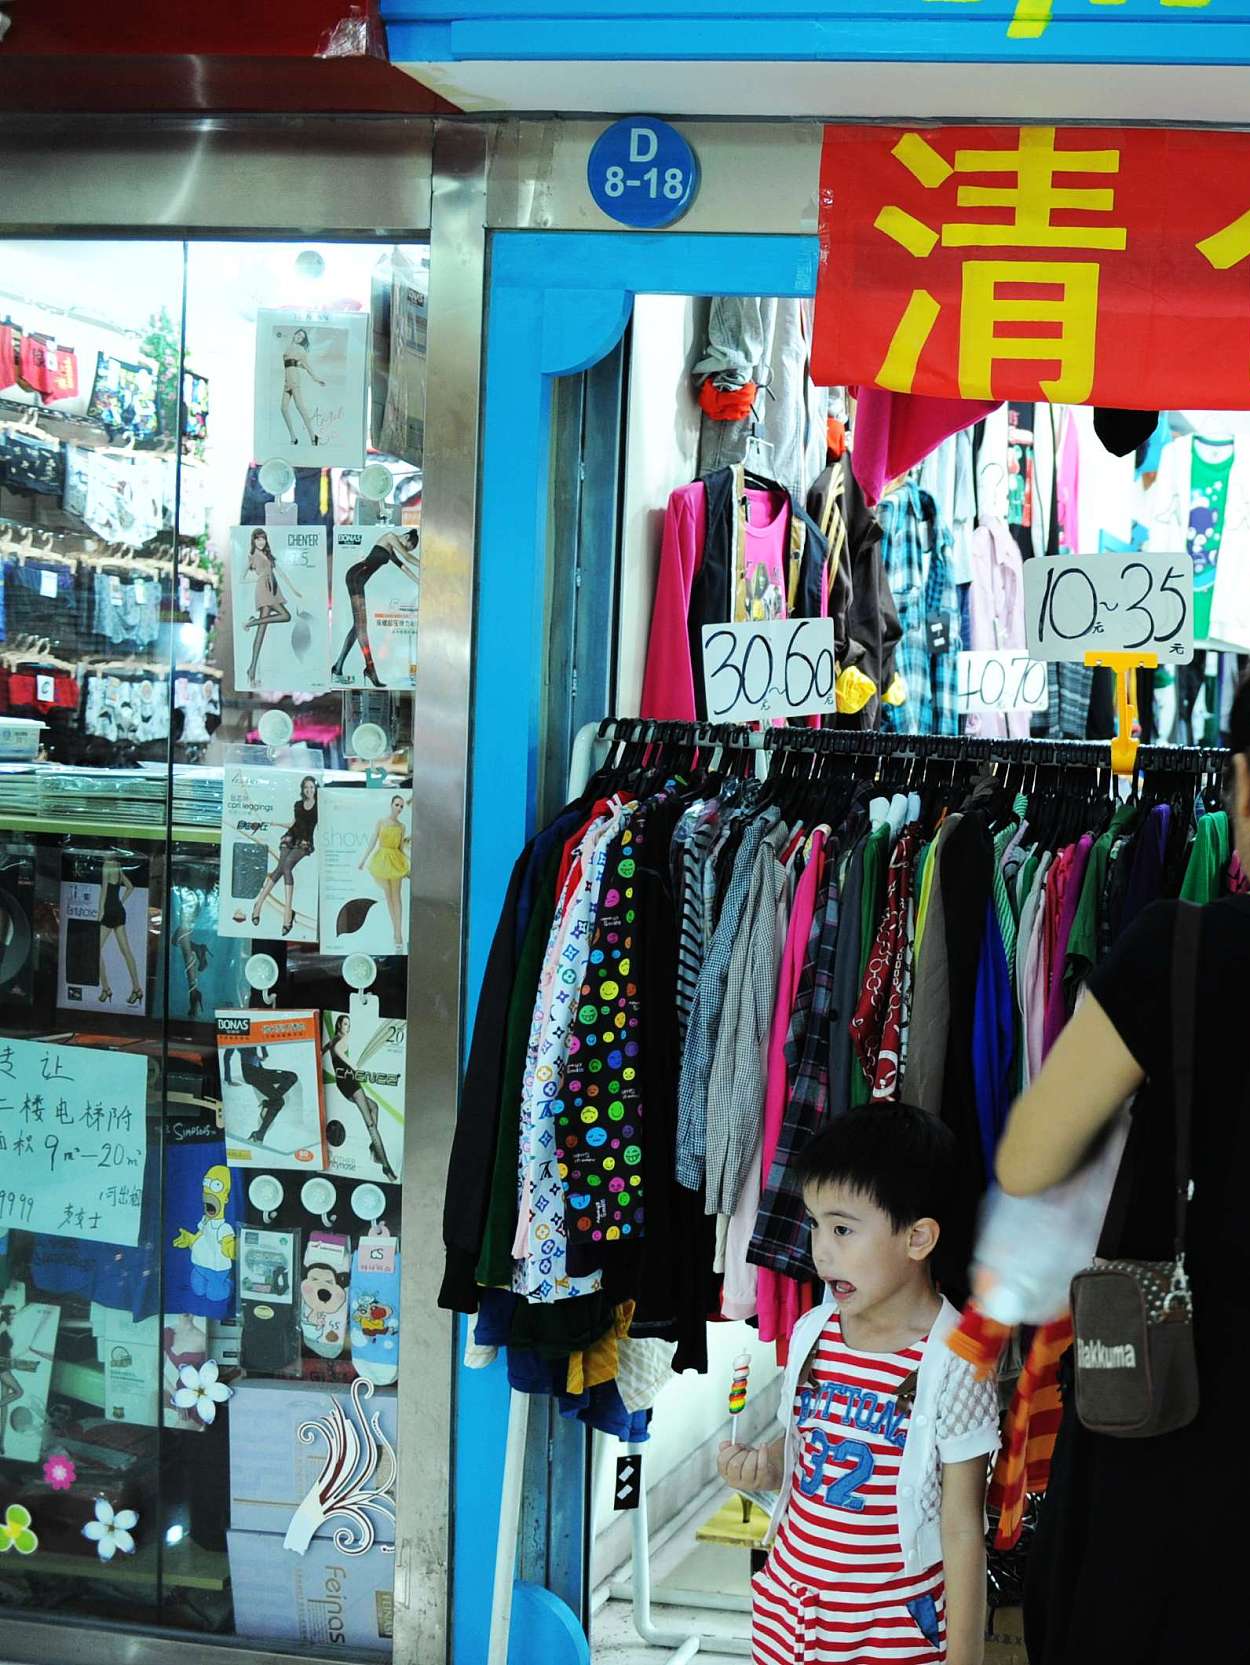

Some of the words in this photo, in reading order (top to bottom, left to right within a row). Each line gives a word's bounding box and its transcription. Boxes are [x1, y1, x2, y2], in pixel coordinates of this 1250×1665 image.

[629, 127, 659, 163] D
[604, 166, 684, 200] 8-18
[217, 1019, 249, 1031] BONAS
[800, 1427, 875, 1511] 32
